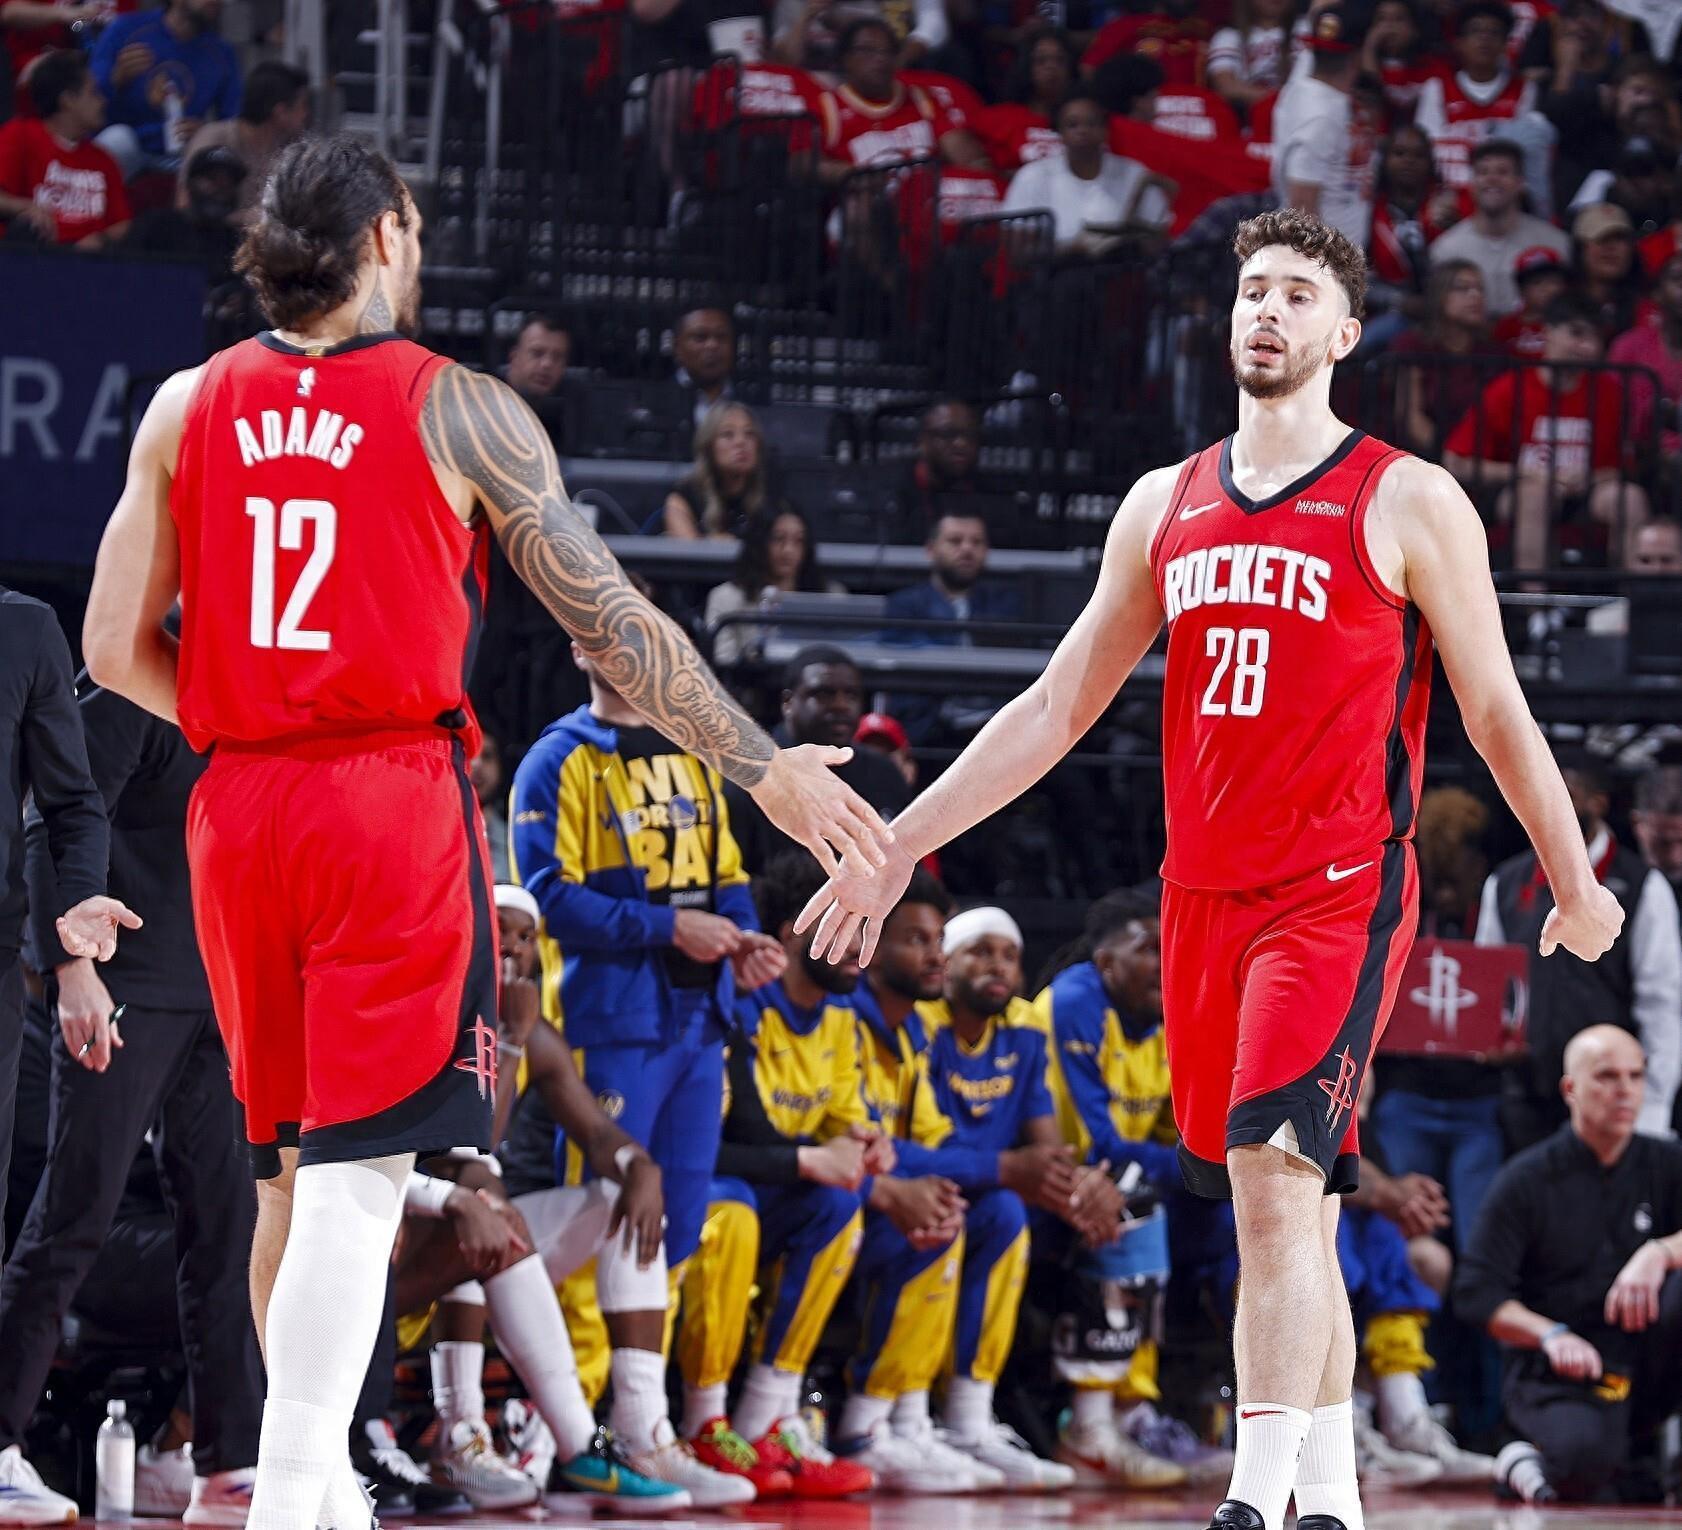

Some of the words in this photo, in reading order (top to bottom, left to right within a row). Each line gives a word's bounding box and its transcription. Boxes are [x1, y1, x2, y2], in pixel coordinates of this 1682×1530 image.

[234, 406, 365, 470] ADAMS
[1294, 504, 1345, 517] HERMANN
[1296, 499, 1346, 511] MEMORIAL
[245, 496, 337, 651] 12
[1165, 543, 1332, 622] ROCKETS
[1200, 627, 1270, 717] 28
[628, 823, 712, 890] BA
